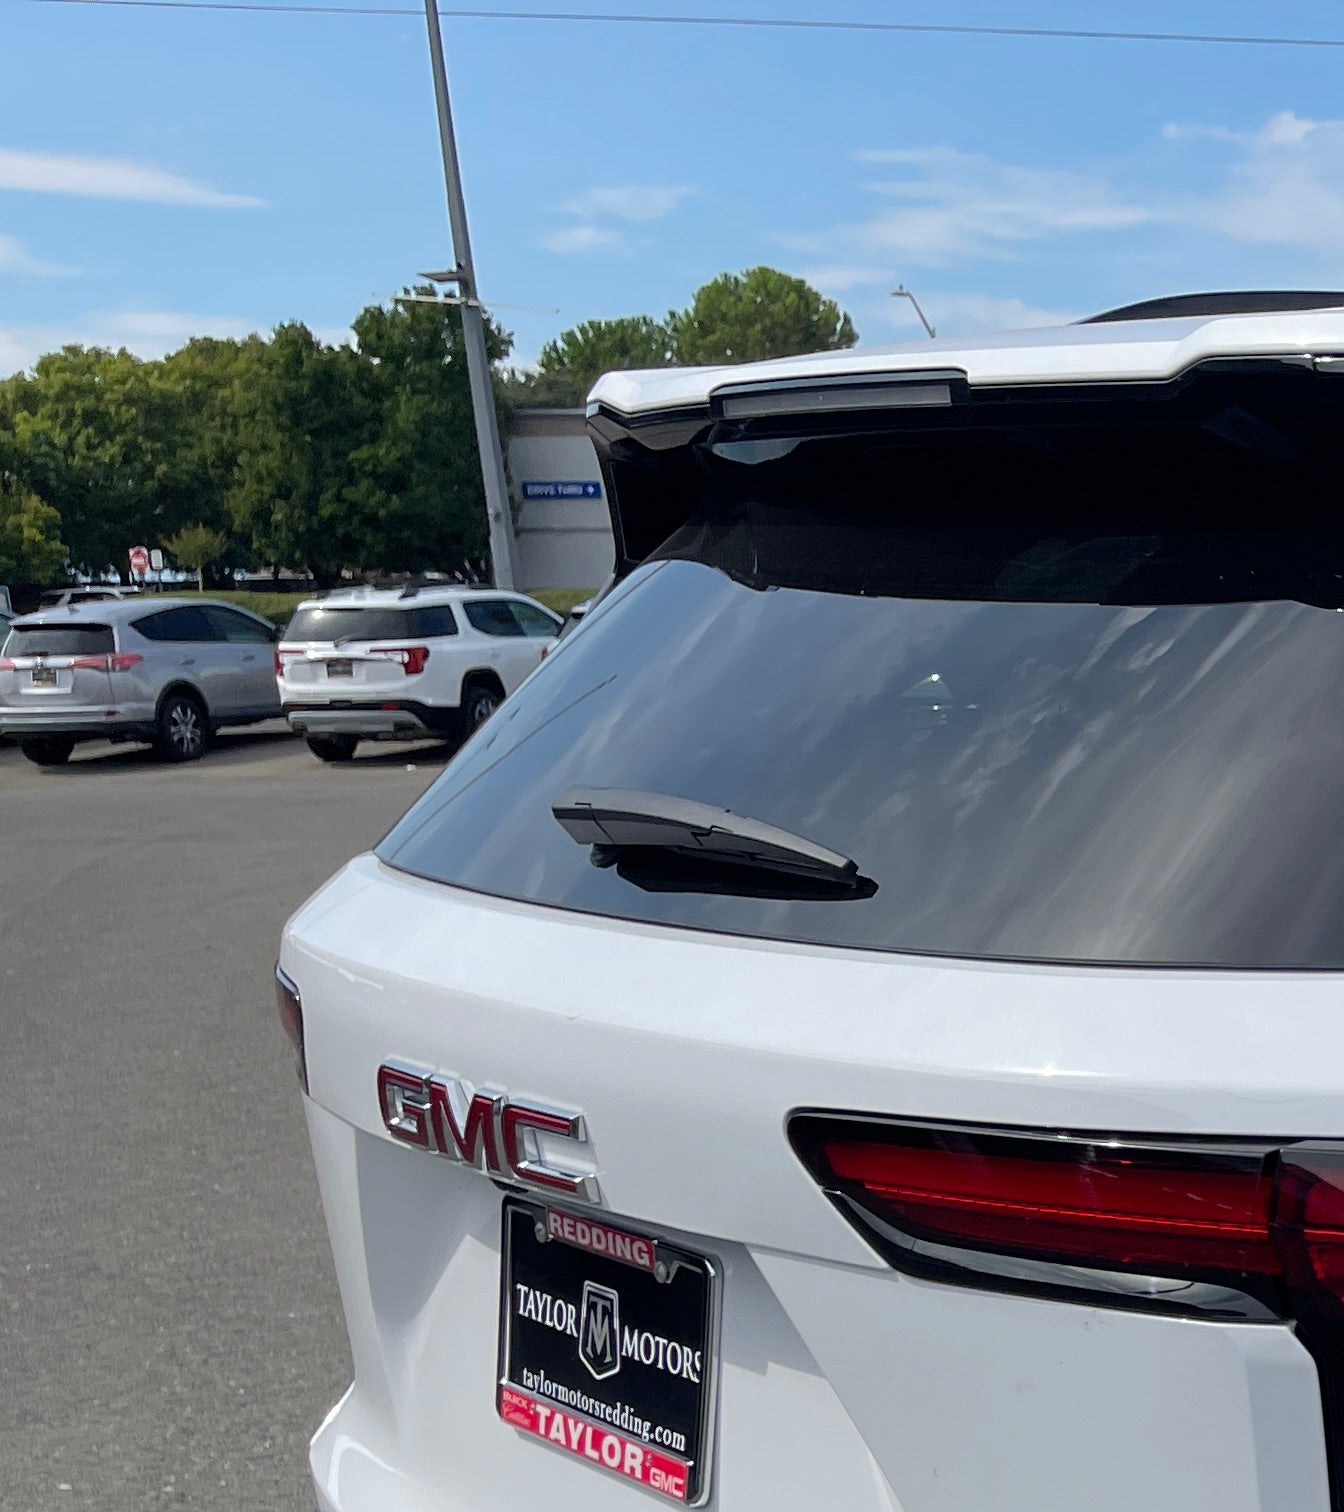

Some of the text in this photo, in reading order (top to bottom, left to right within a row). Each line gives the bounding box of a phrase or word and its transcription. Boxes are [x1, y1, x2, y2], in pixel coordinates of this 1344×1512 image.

[377, 1057, 601, 1202] GMC
[549, 1212, 651, 1267] REDDING
[516, 1283, 579, 1338] TAYLOR
[522, 1367, 686, 1451] taylormotorsredding.com
[536, 1404, 643, 1479] TAYLOR
[650, 1466, 684, 1497] GMC
